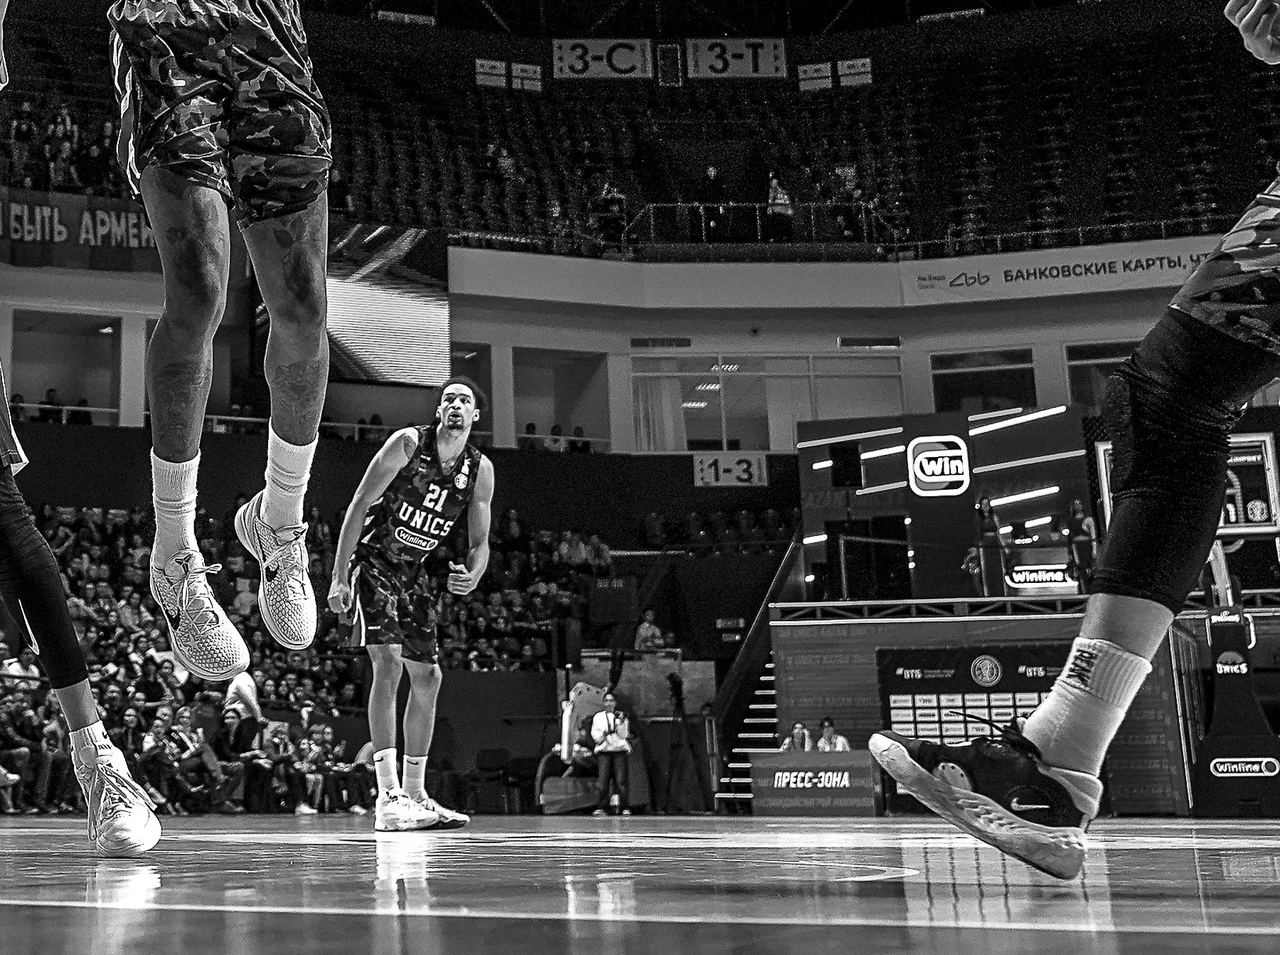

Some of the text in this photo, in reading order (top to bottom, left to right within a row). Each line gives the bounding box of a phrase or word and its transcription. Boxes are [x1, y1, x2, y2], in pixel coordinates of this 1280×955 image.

[9, 202, 68, 242] БЫТЬ
[1003, 260, 1118, 283] БАНКОВСКИЕ
[1122, 254, 1187, 273] КАРТЫ,
[707, 458, 753, 484] 1-3
[921, 457, 964, 475] Win
[423, 483, 449, 513] 21
[398, 502, 455, 537] UNICS
[399, 529, 428, 548] Winline
[1012, 570, 1064, 583] Winline
[1216, 662, 1249, 675] UNICS
[1216, 762, 1261, 774] Winline
[773, 771, 851, 789] ПРЕСС-ЗОНА
